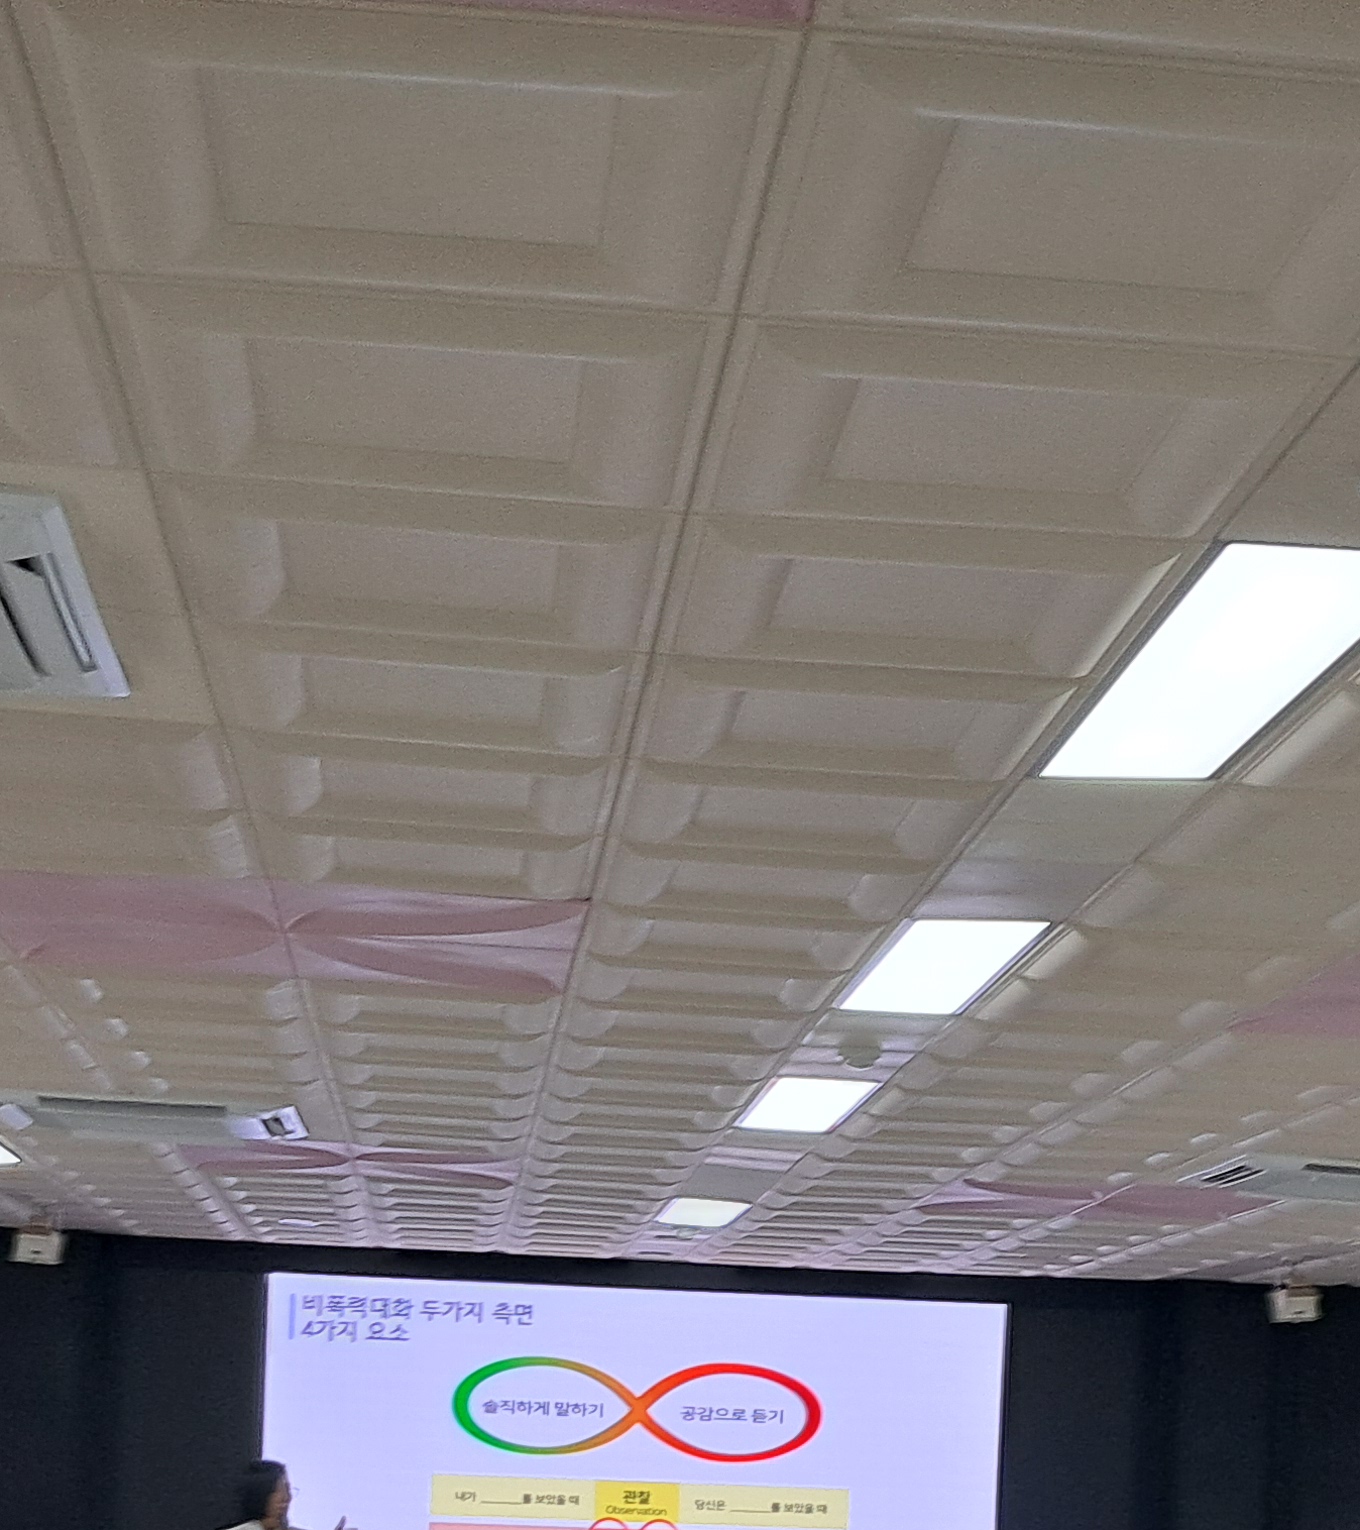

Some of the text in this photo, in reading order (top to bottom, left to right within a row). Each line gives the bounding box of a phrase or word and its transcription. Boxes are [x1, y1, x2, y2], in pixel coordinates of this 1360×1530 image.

[301, 1295, 534, 1326] 비폭력대화 두가지 측면
[301, 1320, 411, 1342] 4가지 요소
[482, 1399, 604, 1418] 솔직하게 말하기
[680, 1406, 785, 1424] 공감으로 듣기
[605, 1505, 668, 1517] Observation
